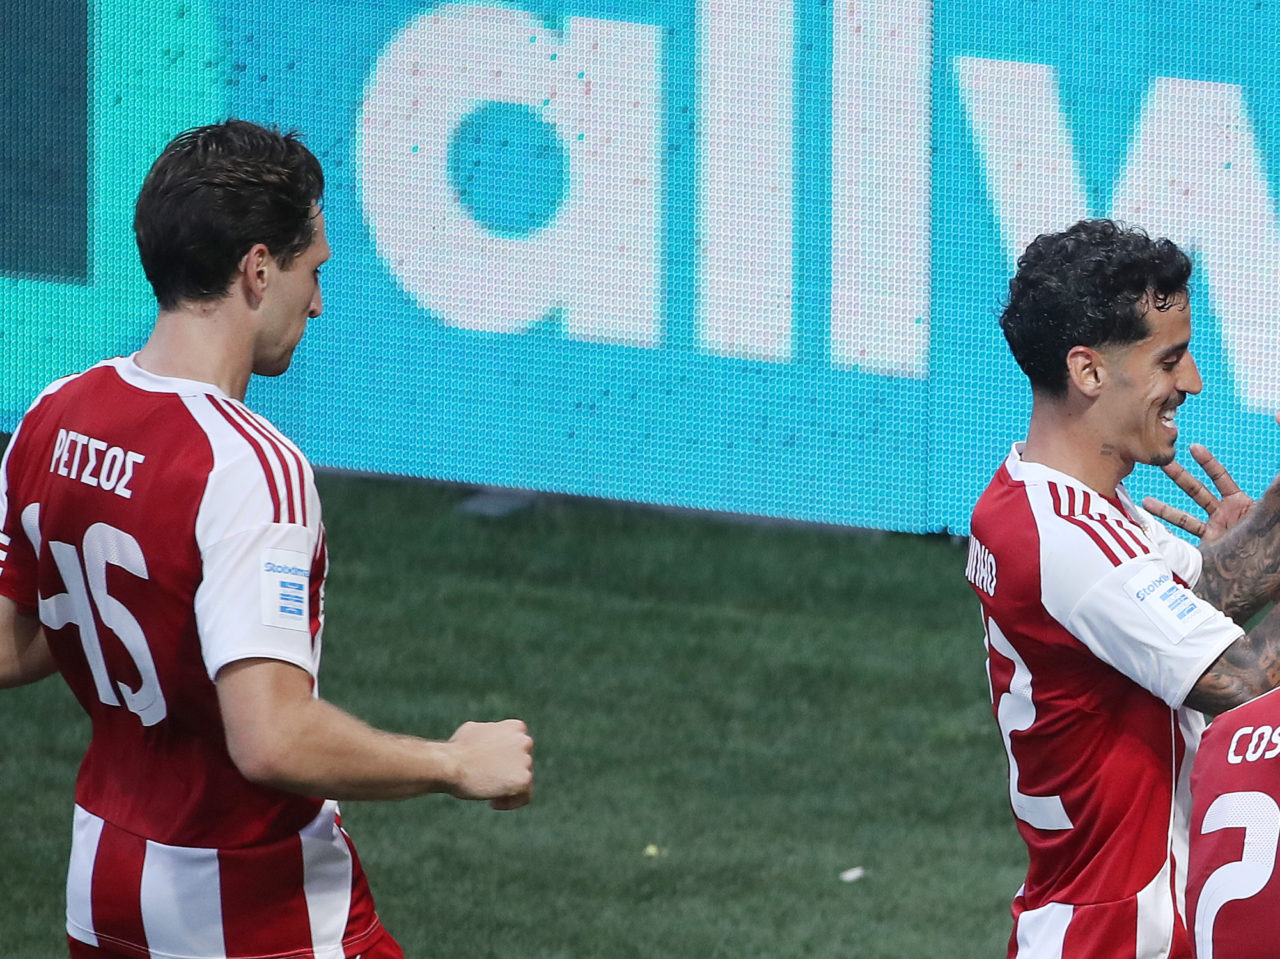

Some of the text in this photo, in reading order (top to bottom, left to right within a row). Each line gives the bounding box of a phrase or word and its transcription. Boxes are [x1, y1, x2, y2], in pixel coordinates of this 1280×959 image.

[50, 428, 146, 499] ΡΕΤΣΟΣ
[21, 502, 167, 726] 45
[979, 603, 1075, 831] 2
